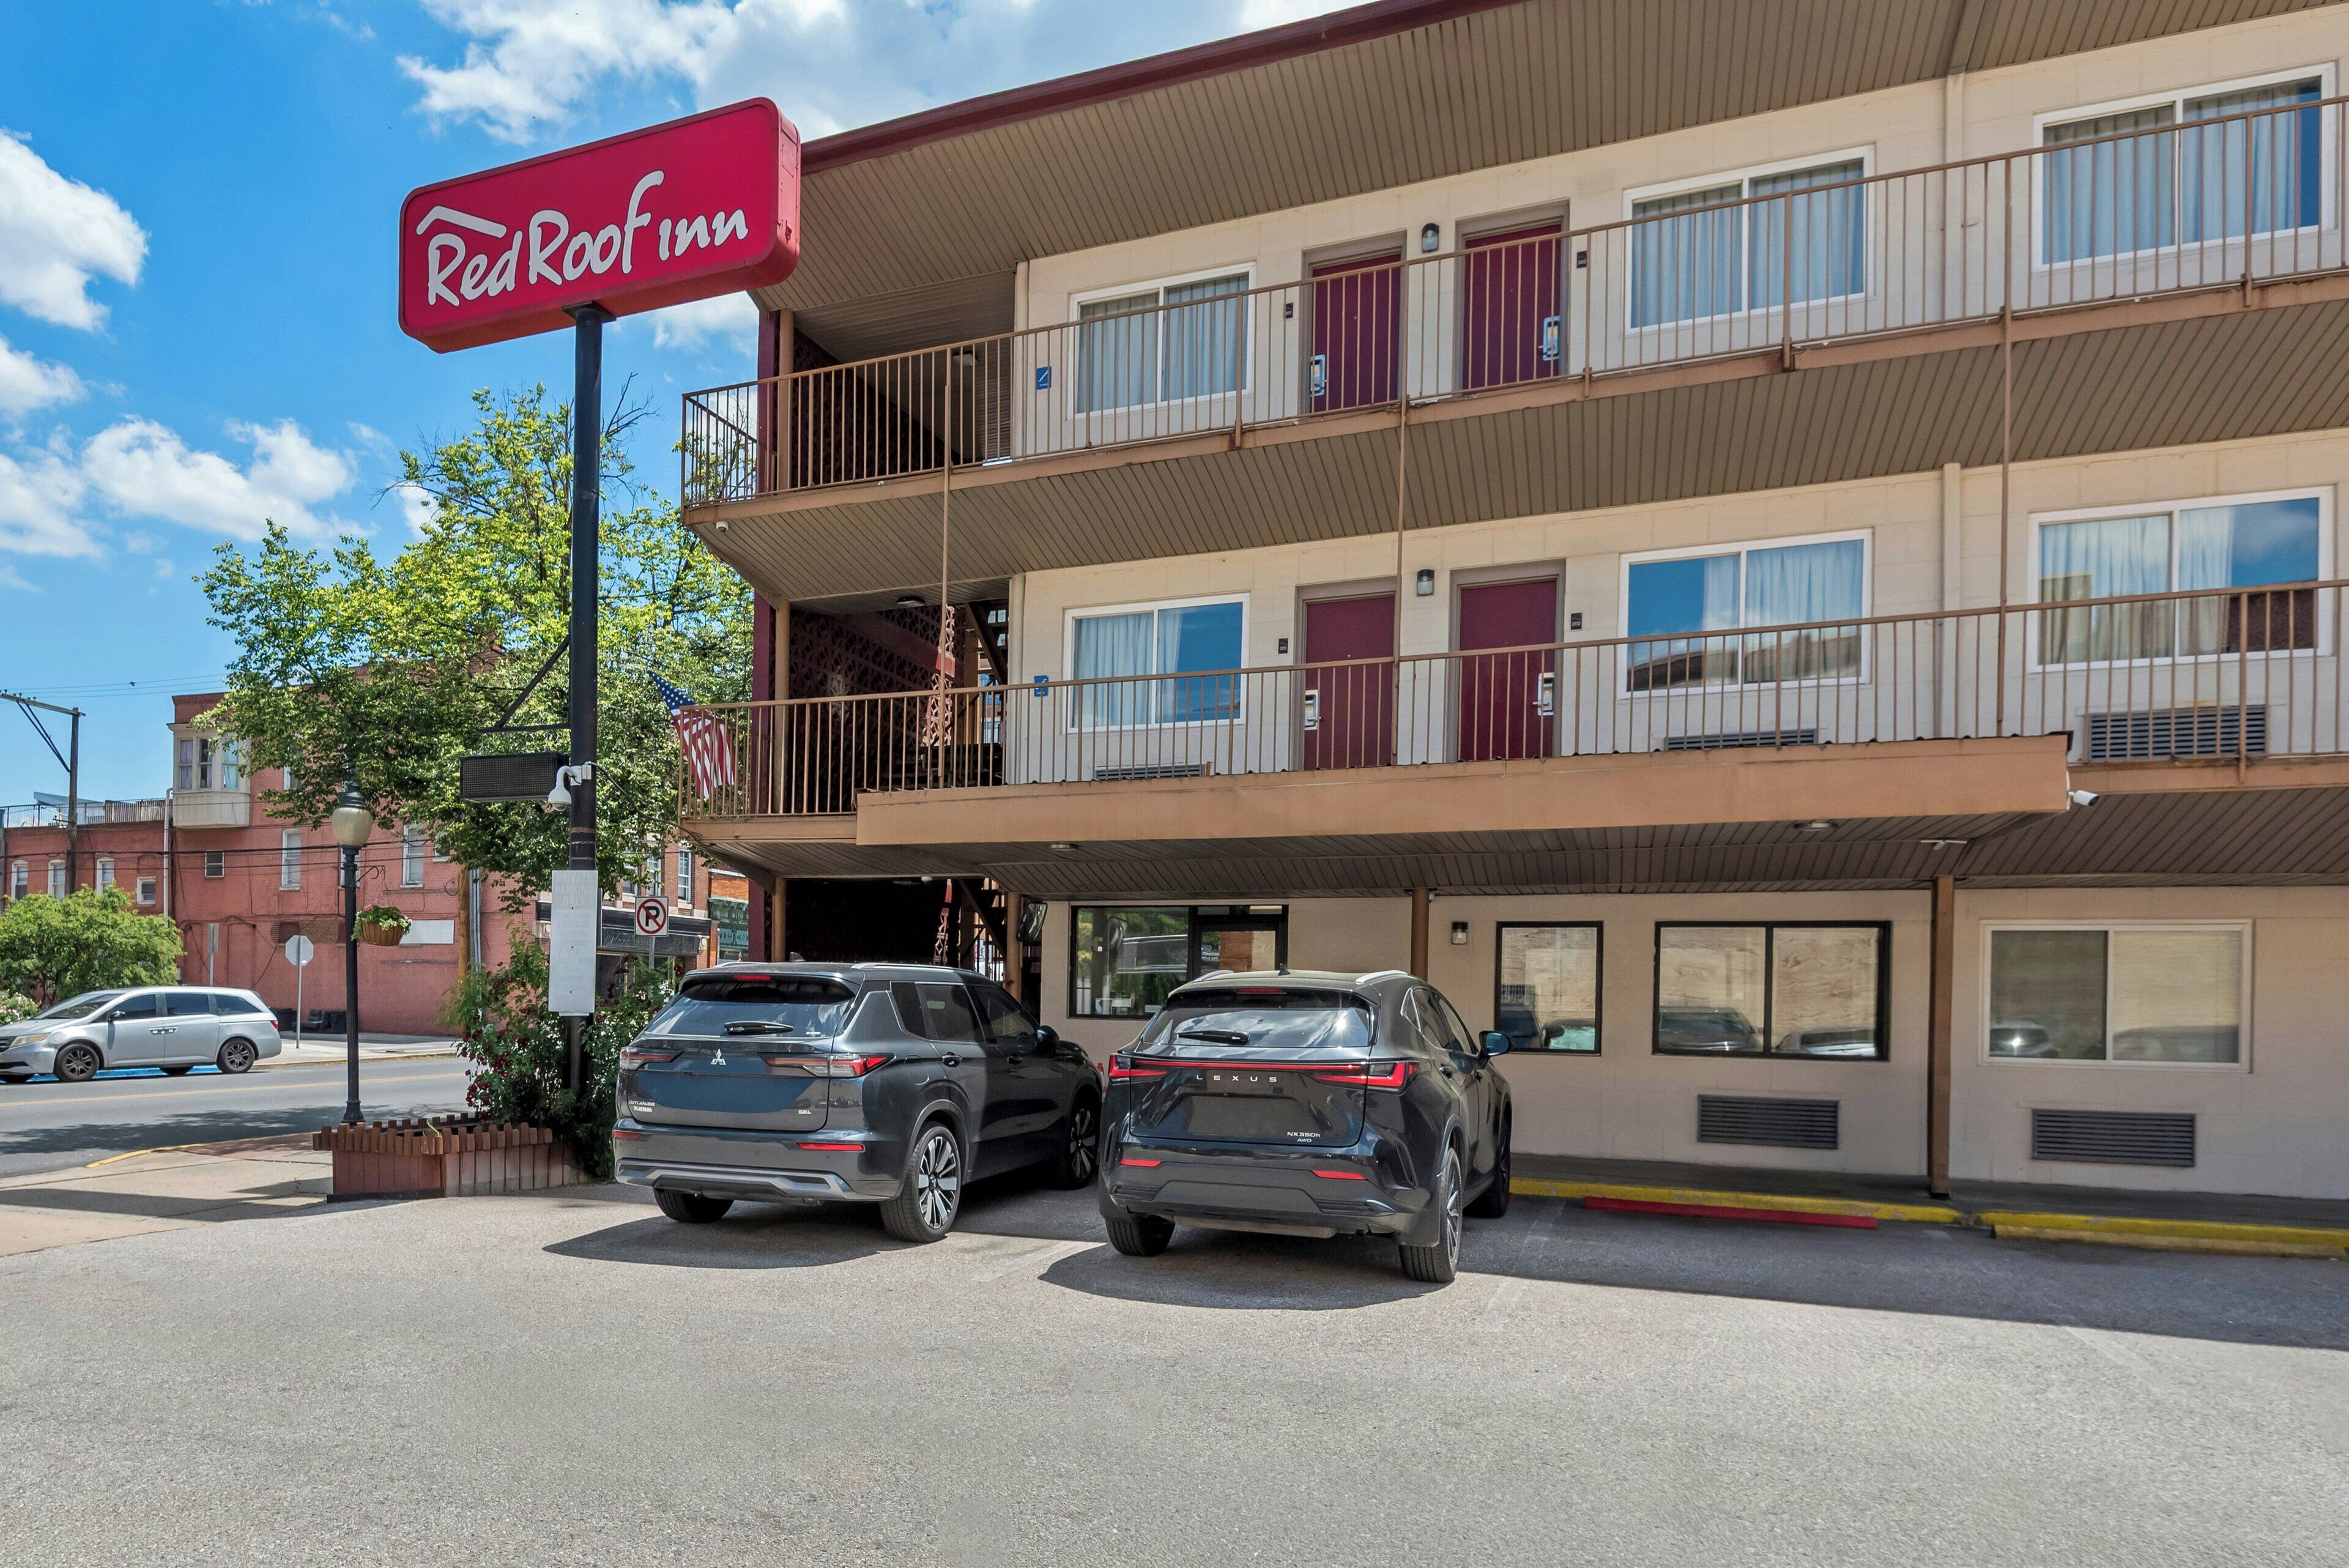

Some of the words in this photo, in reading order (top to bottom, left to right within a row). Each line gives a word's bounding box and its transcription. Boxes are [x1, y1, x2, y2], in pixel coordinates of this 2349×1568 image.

[428, 230, 523, 307] Red
[529, 169, 665, 286] Roof
[556, 873, 592, 883] PRIVATE
[555, 885, 593, 895] PARKING
[562, 896, 585, 906] ONLY
